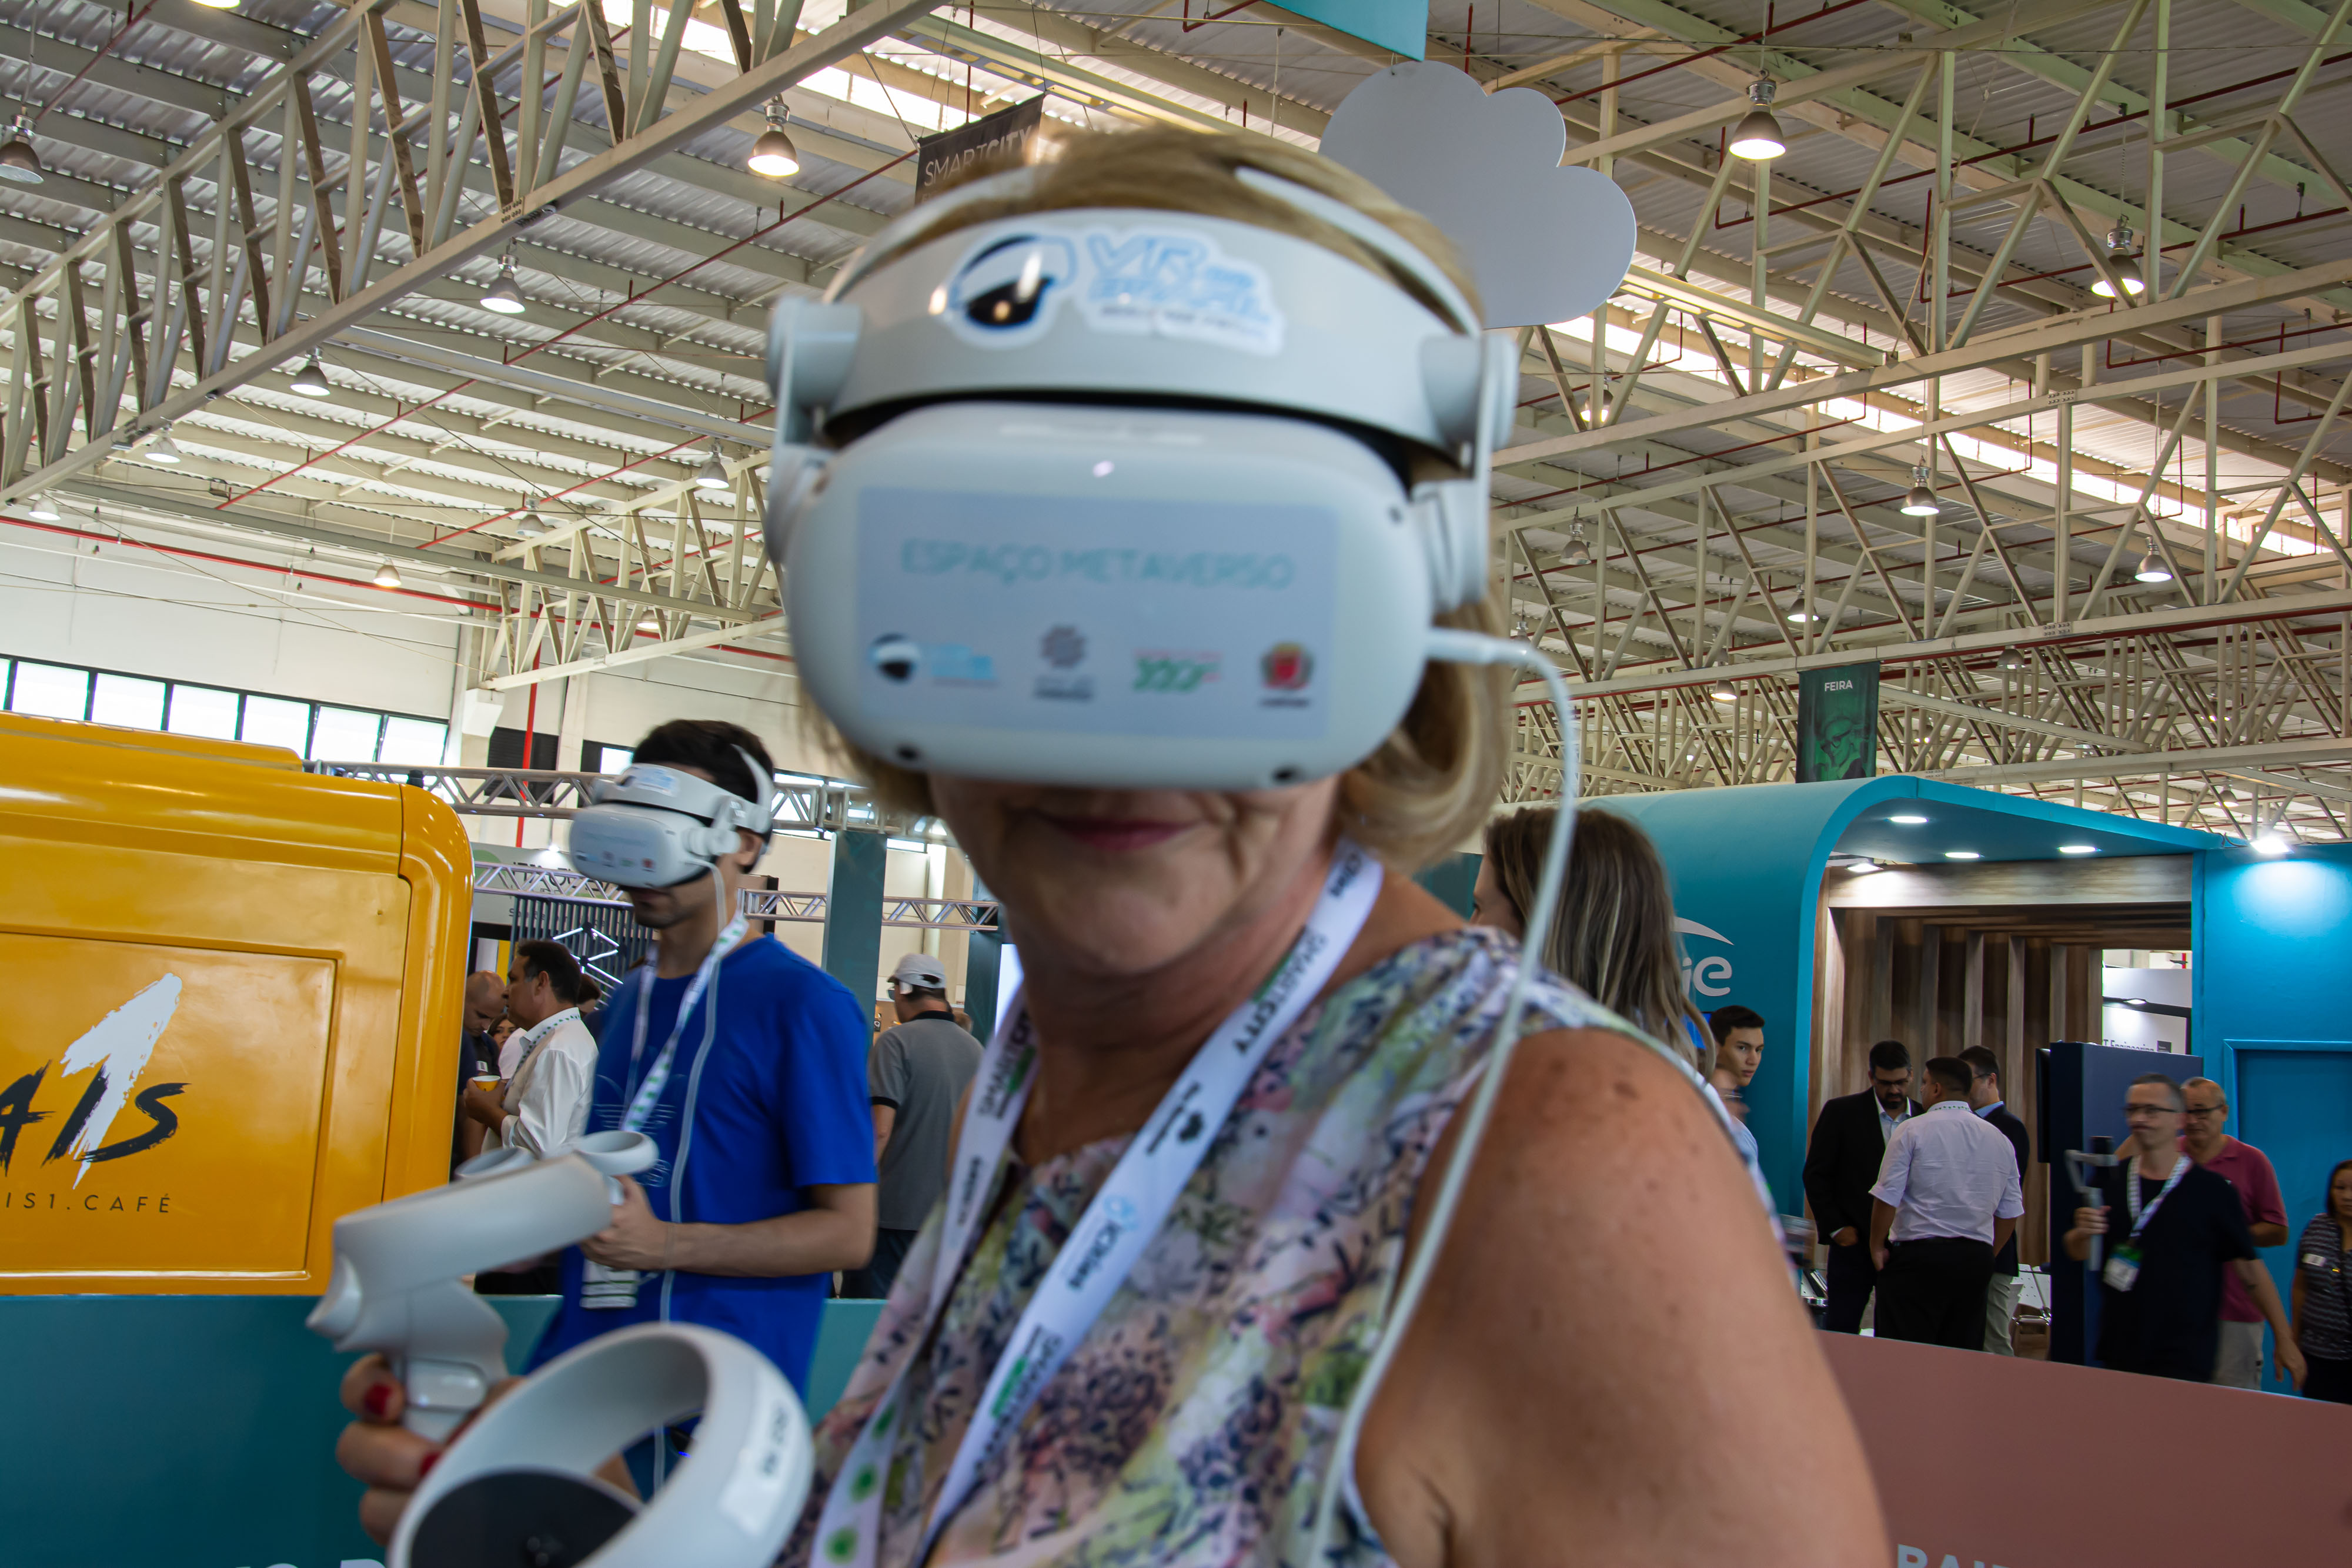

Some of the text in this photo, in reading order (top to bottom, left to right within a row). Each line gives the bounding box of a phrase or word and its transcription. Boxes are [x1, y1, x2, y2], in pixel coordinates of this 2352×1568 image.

[901, 537, 1295, 590] ESPAÇO METAVERSO
[1825, 680, 1853, 691] FEIRA
